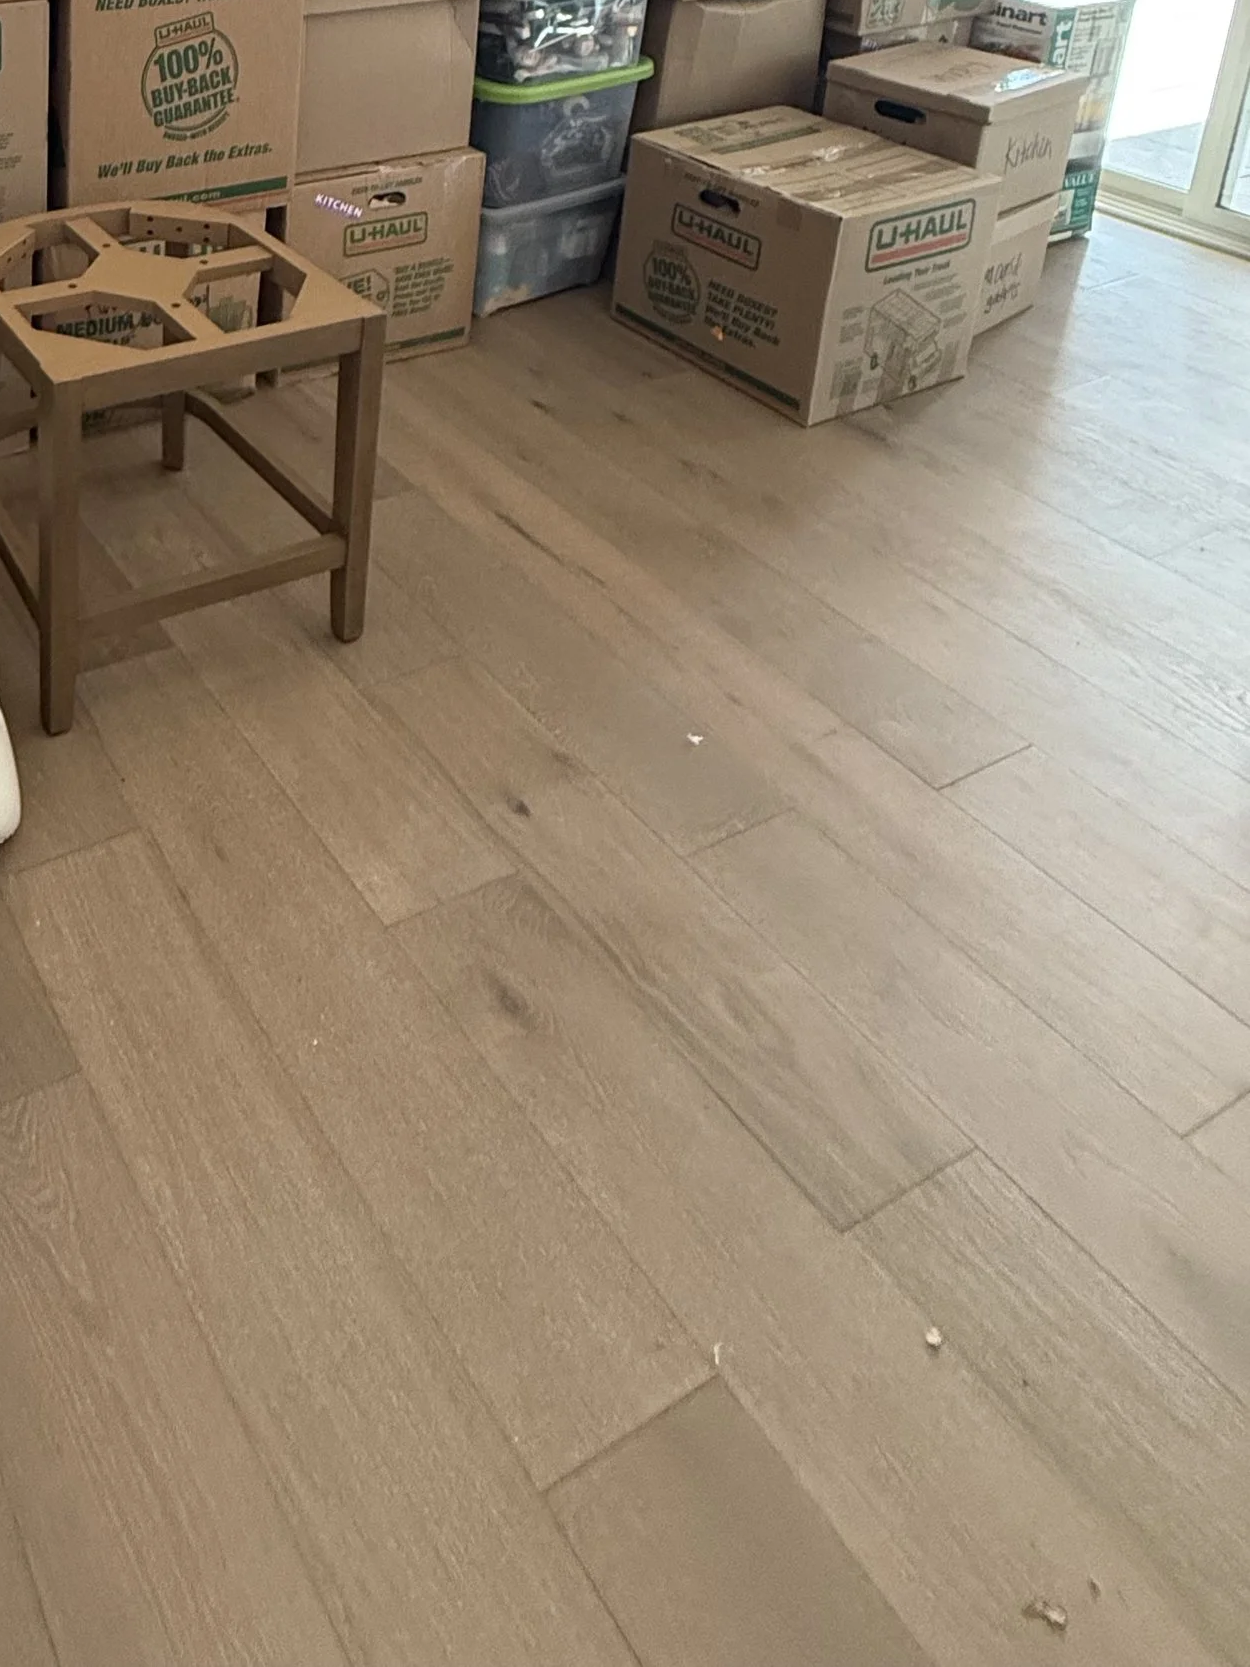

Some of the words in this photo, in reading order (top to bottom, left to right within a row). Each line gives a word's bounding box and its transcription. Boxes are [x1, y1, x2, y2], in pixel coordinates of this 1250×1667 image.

[153, 37, 224, 83] 100%
[151, 65, 232, 108] BUY-BACK
[98, 160, 132, 179] We'll
[136, 157, 163, 174] Buy
[165, 151, 199, 170] Back
[203, 148, 225, 163] the
[228, 141, 273, 160] Extras.
[315, 193, 363, 218] KITCHEN
[350, 218, 423, 244] U-HAUL
[678, 210, 754, 255] U-HAUL
[876, 209, 967, 251] U-HAUL
